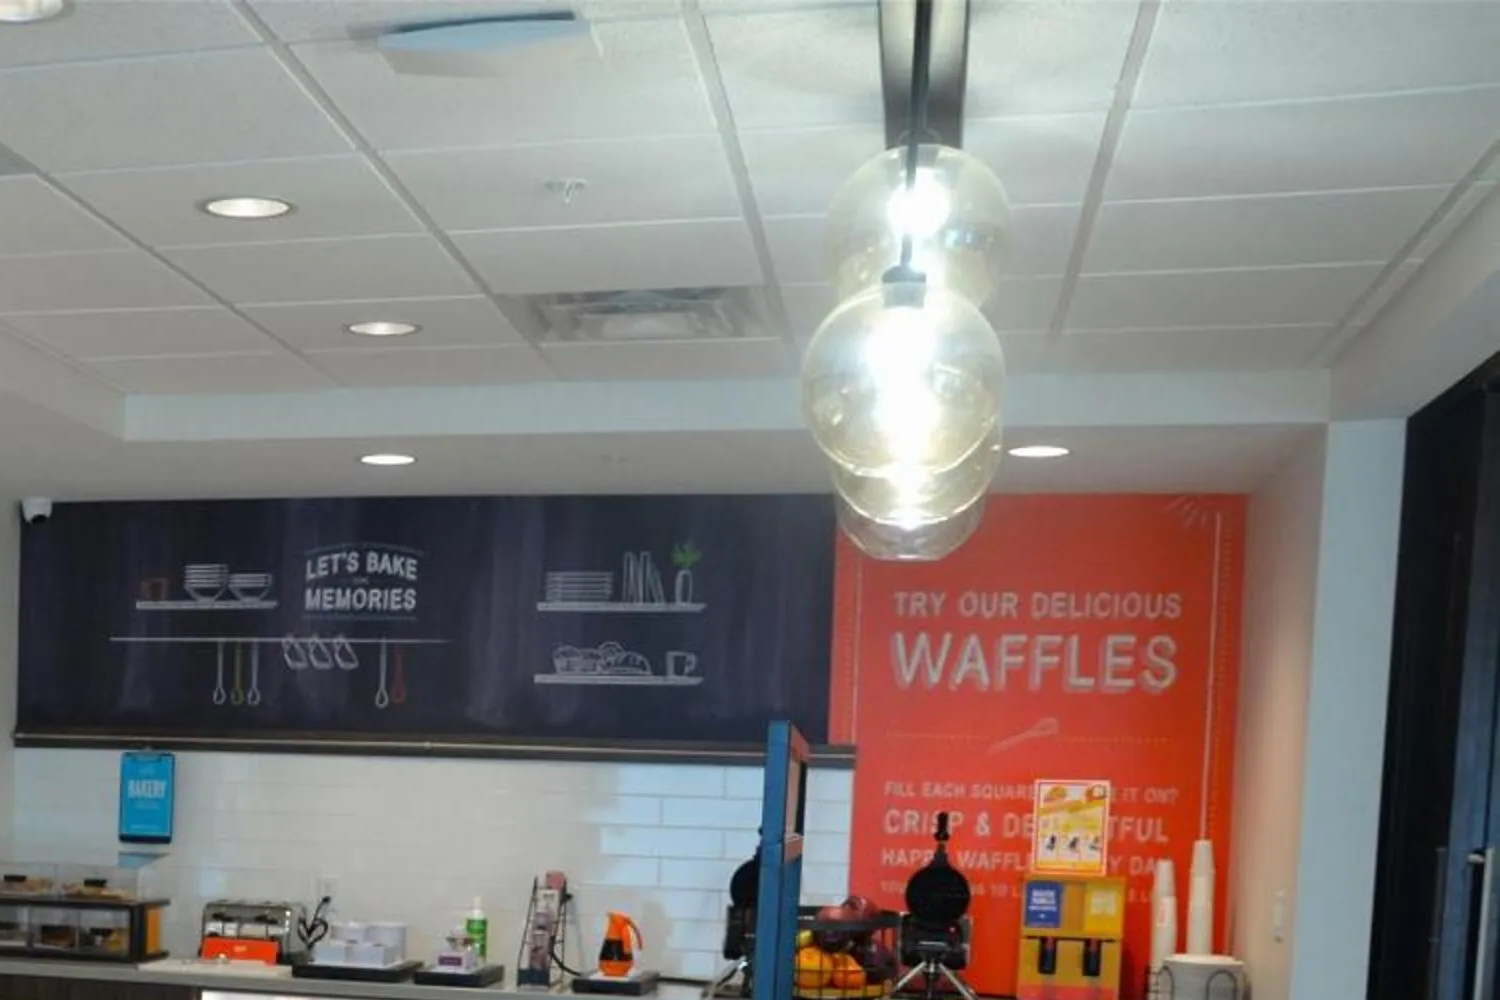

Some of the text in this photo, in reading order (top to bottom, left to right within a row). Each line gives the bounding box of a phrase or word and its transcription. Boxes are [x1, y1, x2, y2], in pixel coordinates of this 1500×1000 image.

[306, 550, 418, 580] LET'S BAKE
[305, 587, 417, 611] MEMORIES
[894, 591, 1183, 619] TRY OUR DELICIOUS
[890, 631, 1178, 692] WAFFLES
[884, 781, 915, 798] FILL
[922, 782, 965, 798] EACH
[976, 810, 991, 837] &
[882, 849, 936, 868] HAPP
